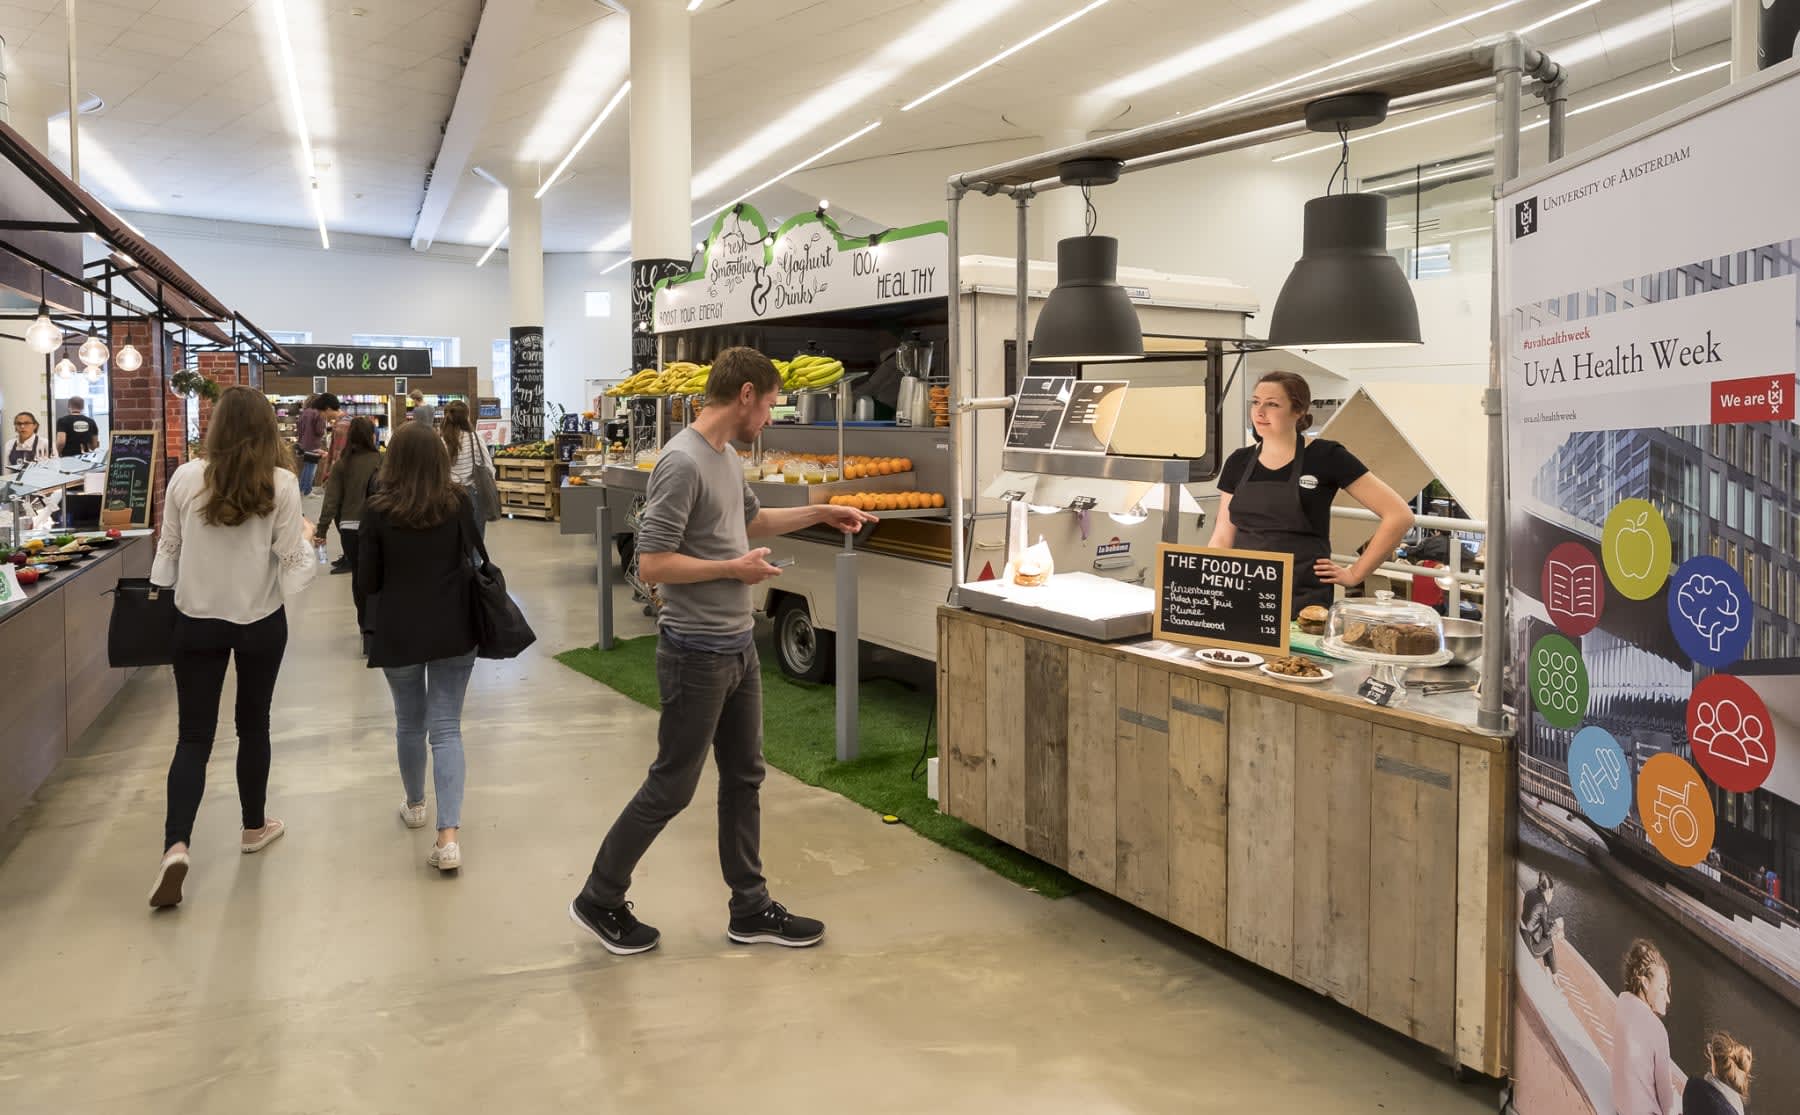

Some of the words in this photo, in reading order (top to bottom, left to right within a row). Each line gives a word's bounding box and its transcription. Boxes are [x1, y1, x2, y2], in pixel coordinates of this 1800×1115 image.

[722, 232, 747, 257] Fresh
[710, 255, 757, 284] Smoothies
[783, 244, 833, 286] Yoghurt
[852, 251, 880, 277] 100%
[775, 284, 813, 309] Drinks
[680, 307, 696, 324] YOUR
[699, 302, 724, 321] ENERGY
[1523, 326, 1591, 350] #uvahealthweek
[316, 352, 354, 370] GRAB
[361, 352, 371, 371] &
[378, 354, 398, 371] GO
[1524, 357, 1567, 387] UvA
[1573, 343, 1644, 381] Health
[1650, 330, 1723, 370] Week
[1720, 394, 1741, 408] We
[1744, 394, 1766, 406] are
[1168, 554, 1197, 569] THE
[1201, 558, 1242, 575] FOOD
[1244, 563, 1277, 580] LAB
[1201, 573, 1252, 591] MENU:
[1258, 592, 1276, 600] 3.50
[1260, 627, 1276, 635] 1.25
